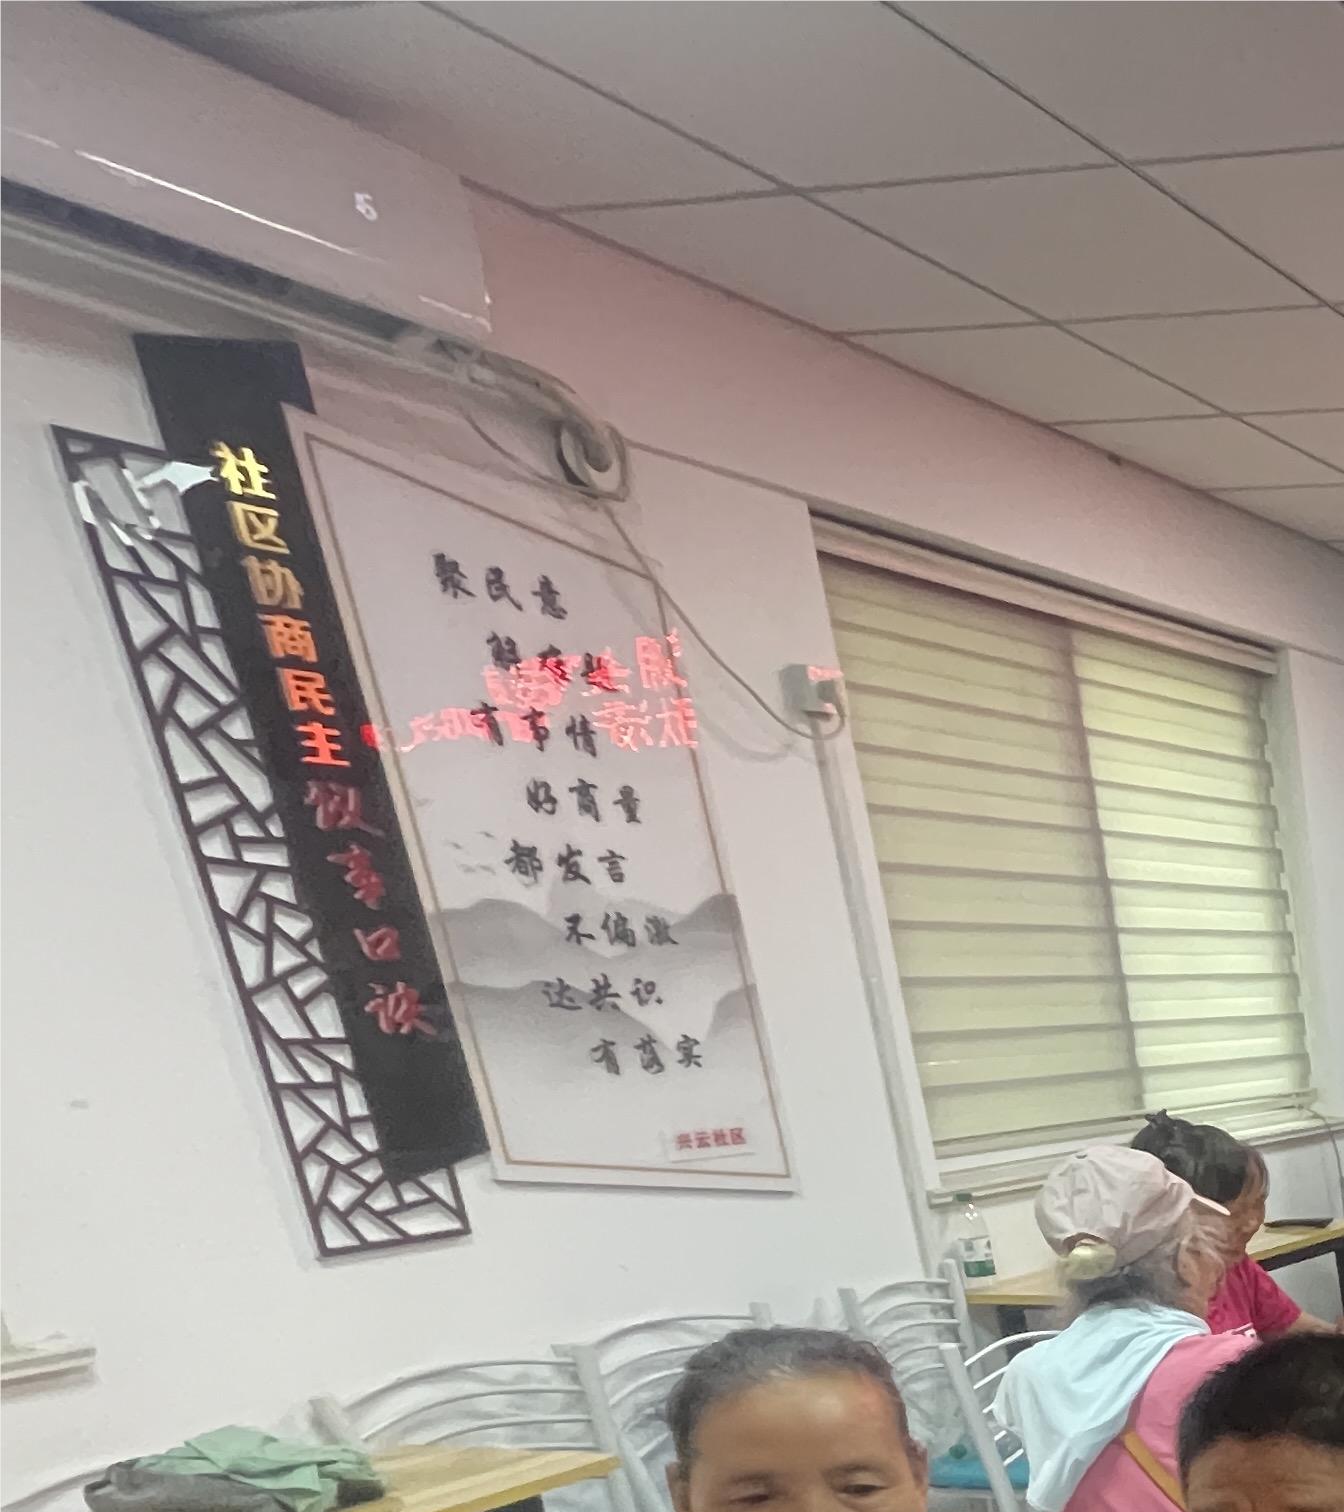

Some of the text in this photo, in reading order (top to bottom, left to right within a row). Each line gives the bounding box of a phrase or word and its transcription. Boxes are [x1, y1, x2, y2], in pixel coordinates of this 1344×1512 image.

[504, 839, 627, 885] 都发言
[542, 973, 663, 1010] 达共识
[676, 1128, 747, 1150] 兴云社区
